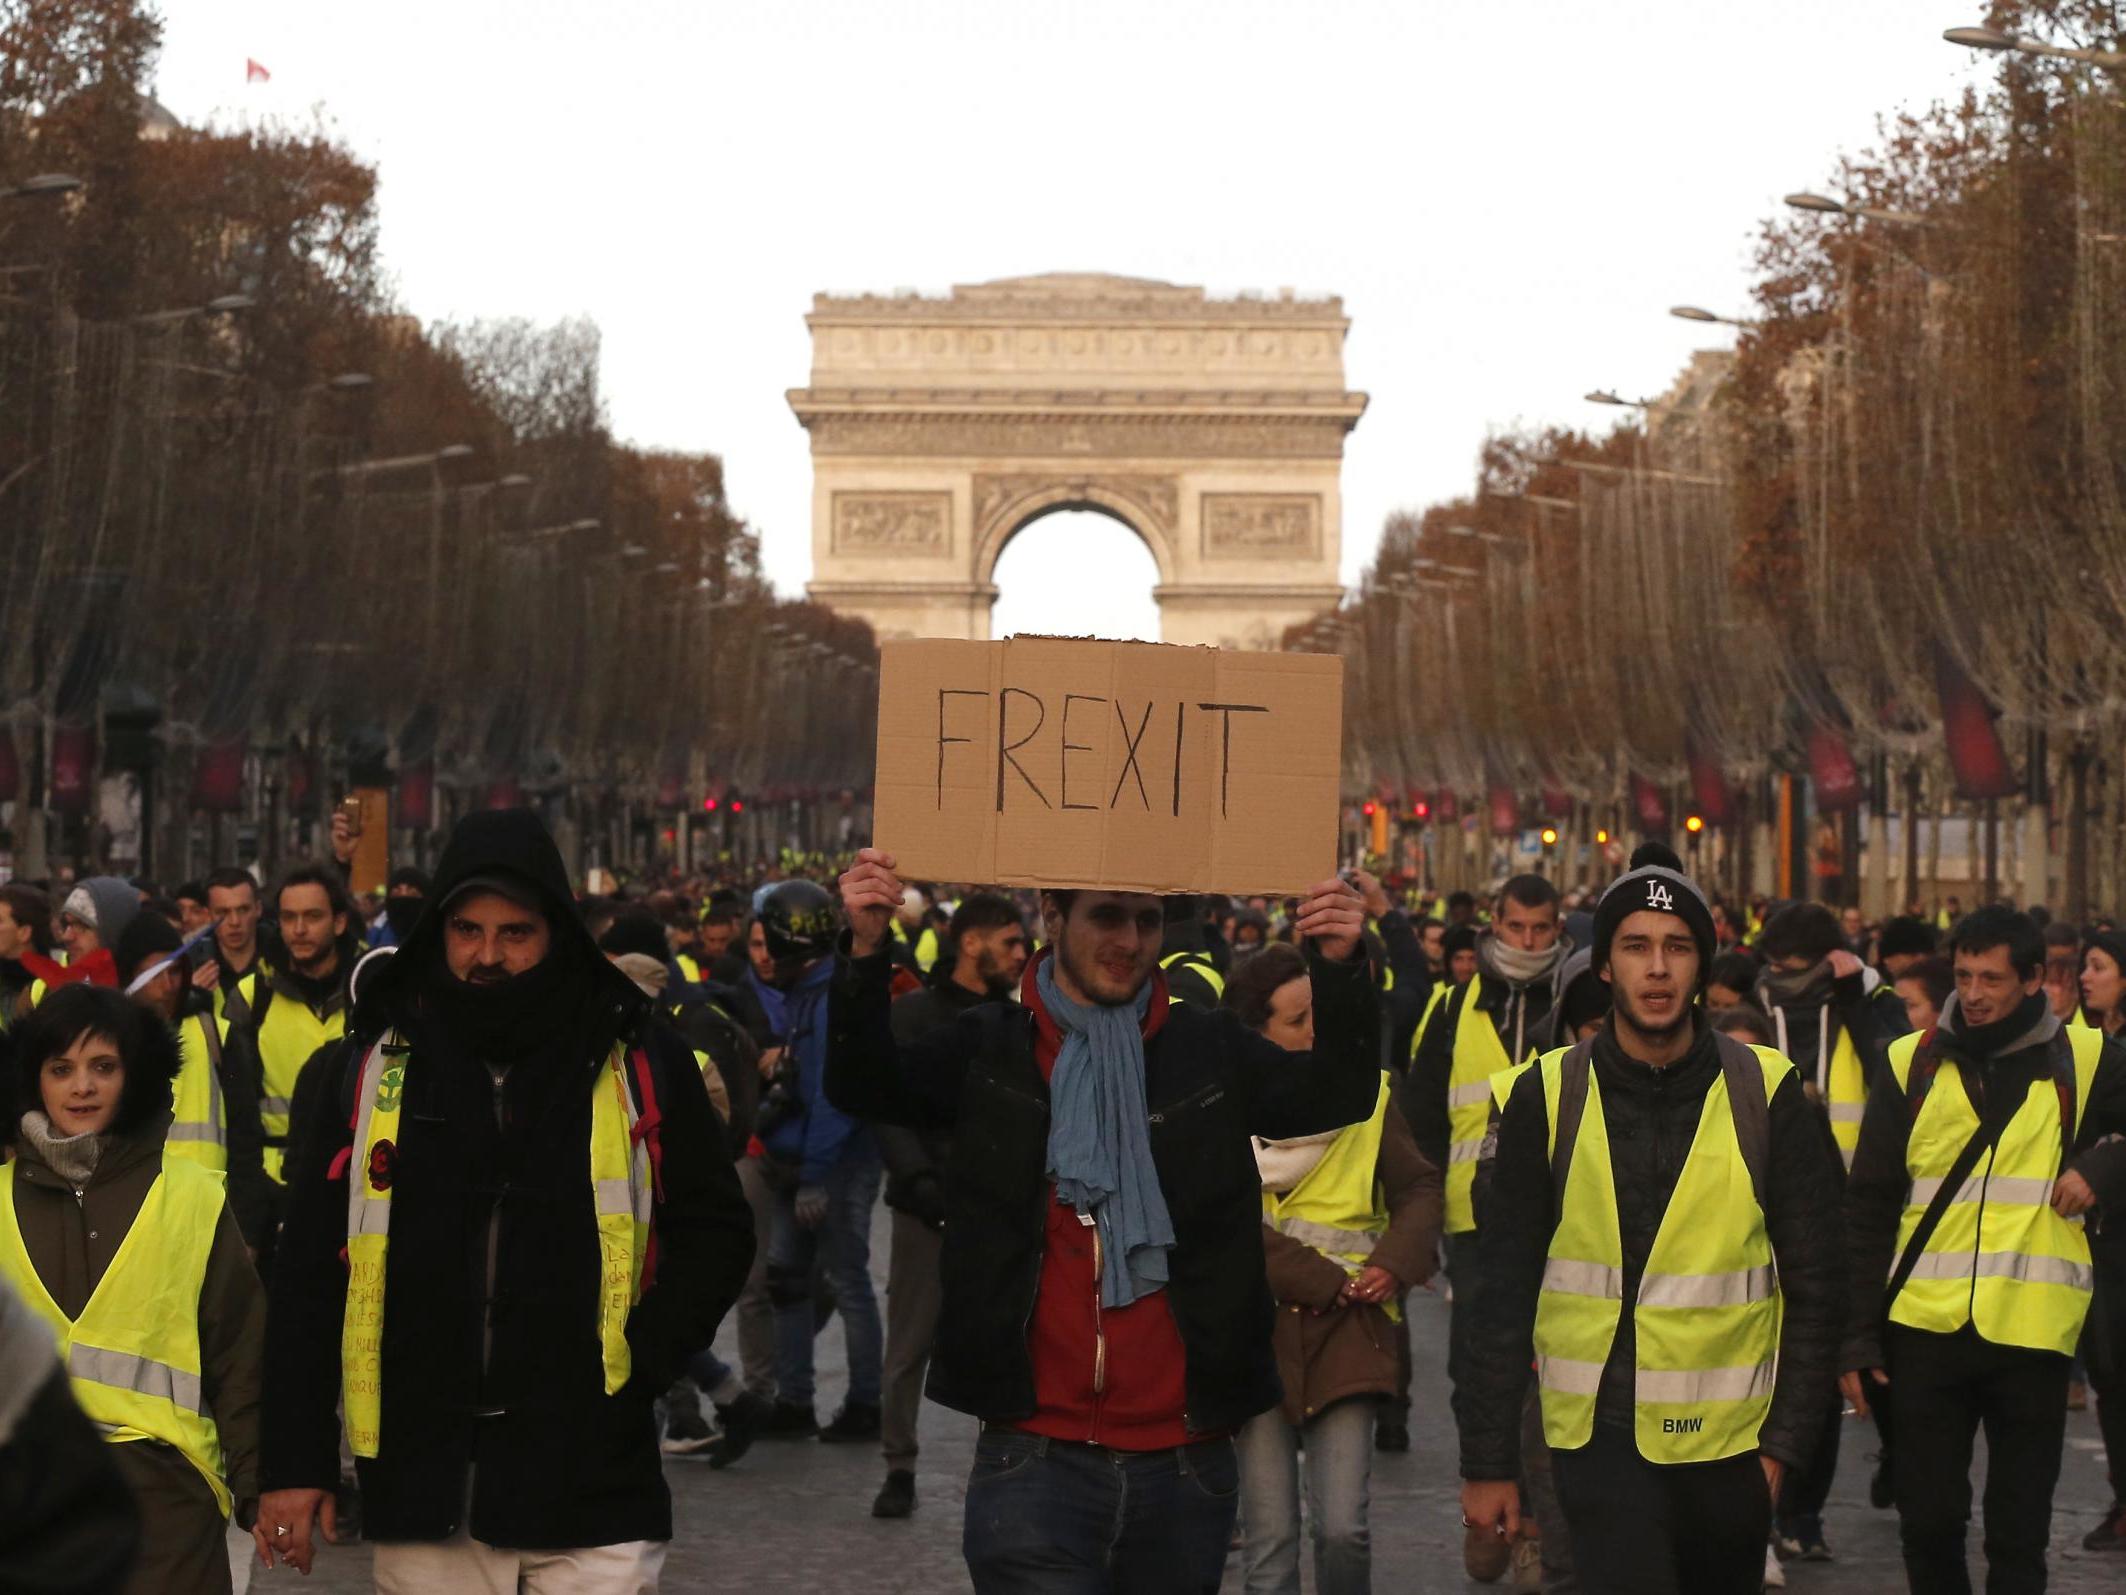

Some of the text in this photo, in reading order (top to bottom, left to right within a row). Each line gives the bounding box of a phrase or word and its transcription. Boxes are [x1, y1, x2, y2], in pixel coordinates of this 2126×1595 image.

[938, 687, 1270, 820] FREXIT
[1646, 880, 1673, 910] LA
[1663, 1417, 1703, 1433] BMW
